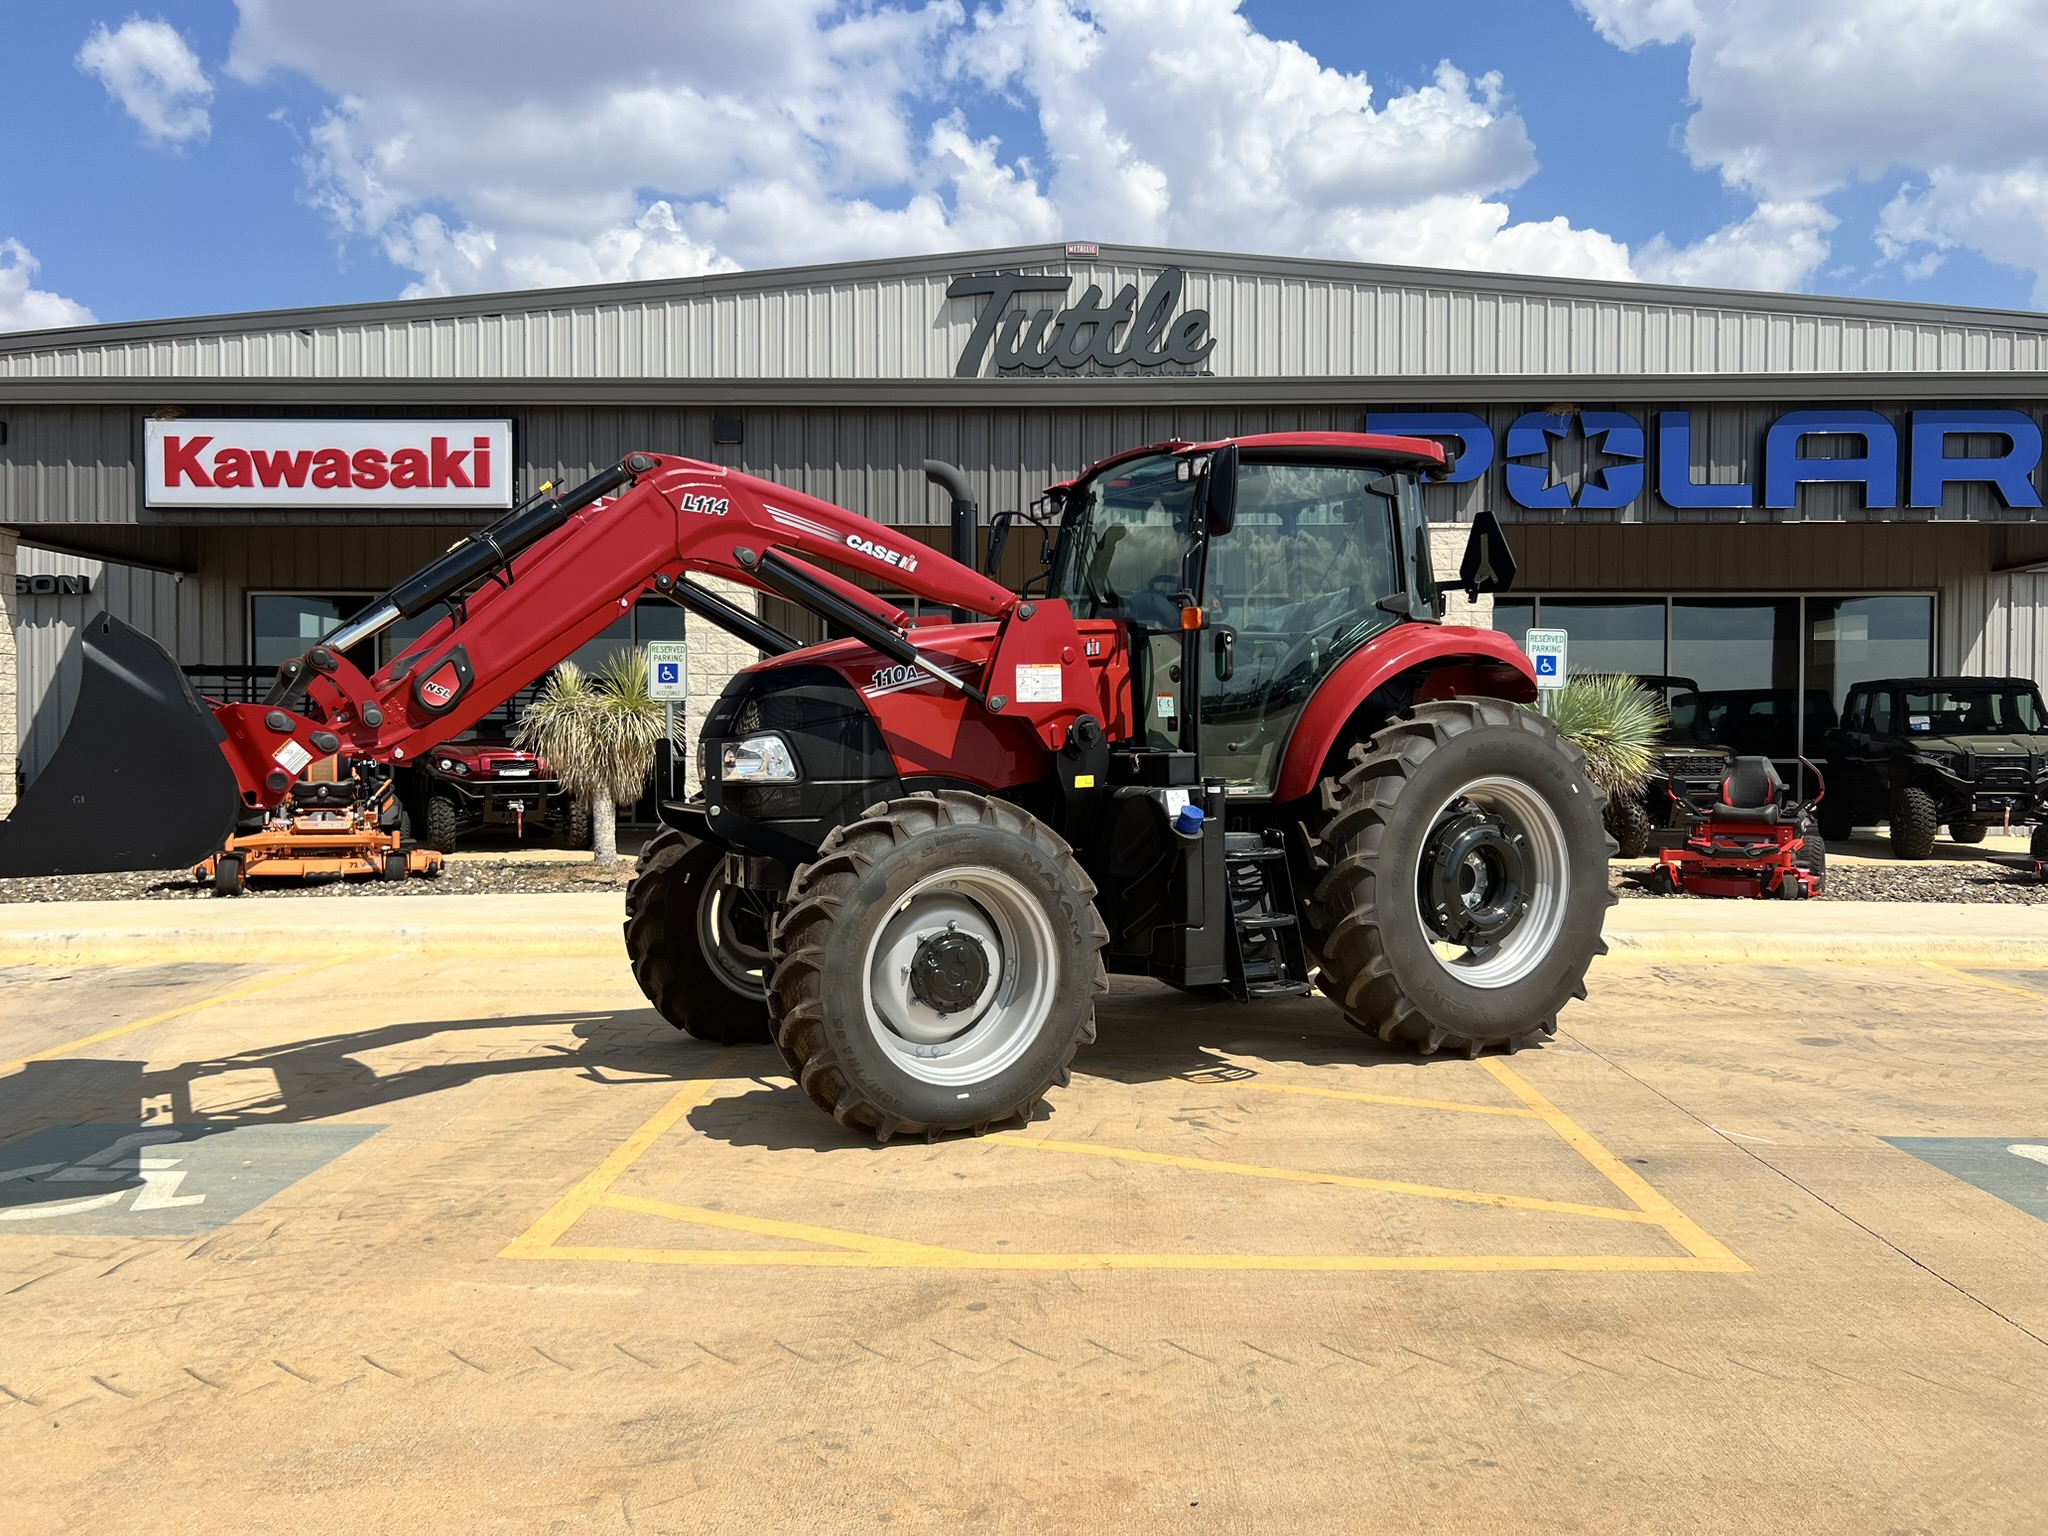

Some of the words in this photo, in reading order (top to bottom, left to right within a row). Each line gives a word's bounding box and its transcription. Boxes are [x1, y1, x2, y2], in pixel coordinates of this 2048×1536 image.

[1068, 245, 1096, 253] METALLIC
[946, 267, 1217, 378] Tuttle
[163, 436, 491, 489] Kawasaki
[681, 493, 729, 516] L114
[846, 535, 900, 565] CASE
[1531, 635, 1564, 643] RESERVED
[1532, 645, 1561, 653] PARKING
[653, 654, 683, 662] PARKING
[424, 681, 450, 699] NSL
[1019, 851, 1083, 945] MAXAM
